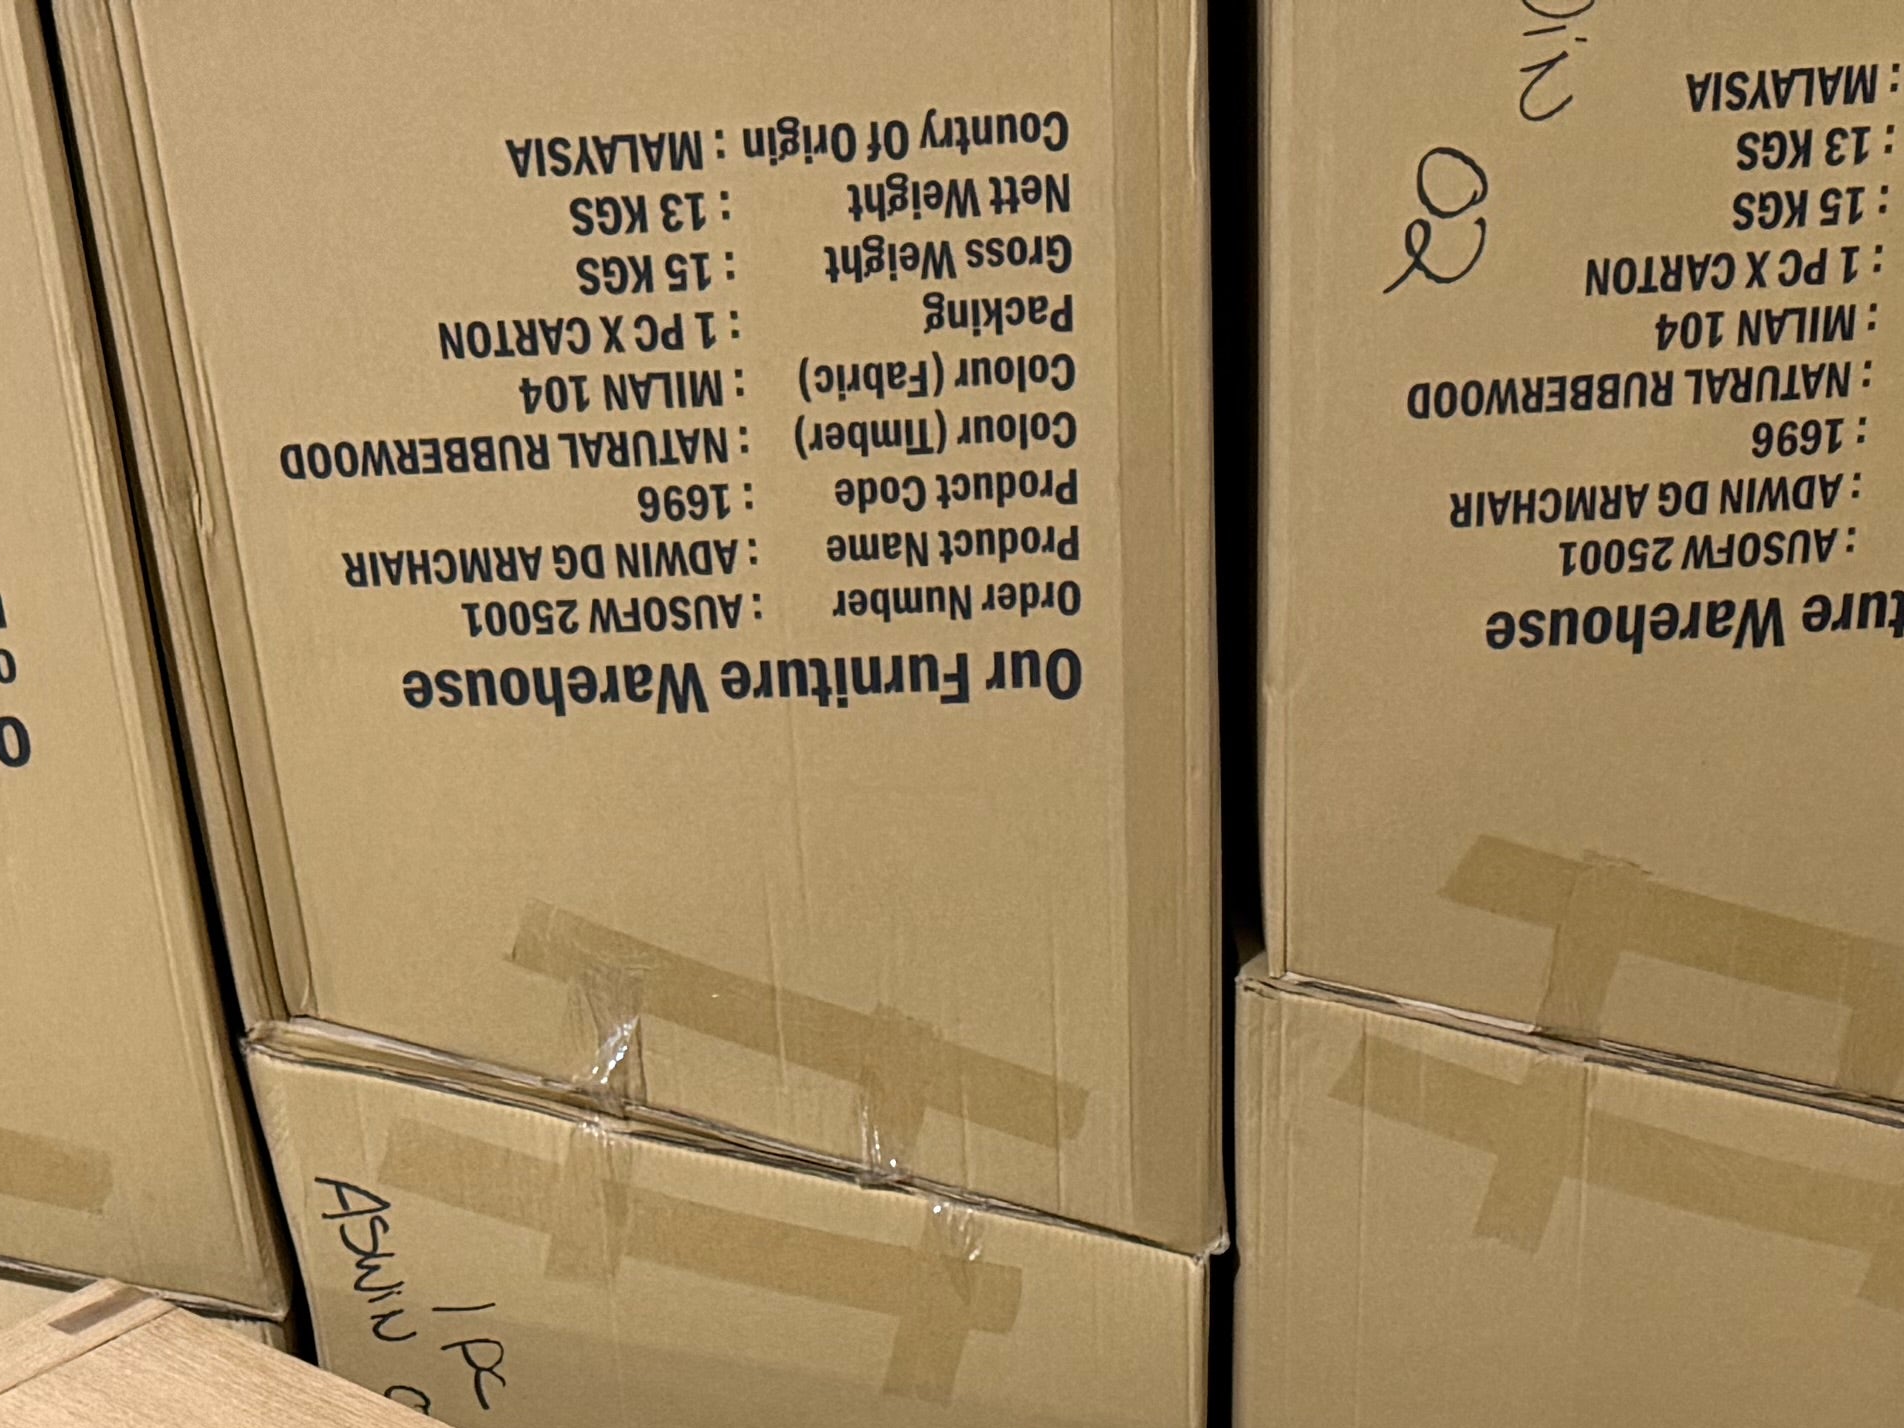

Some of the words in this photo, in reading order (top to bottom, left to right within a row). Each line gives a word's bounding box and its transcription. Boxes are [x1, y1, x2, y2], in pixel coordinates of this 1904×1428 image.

[1685, 63, 1879, 113] MALAYSIA
[1406, 369, 1674, 420] RUBBERWOOD
[1683, 360, 1852, 406] NATURAL
[557, 426, 729, 469] NATURAL
[794, 408, 947, 461] (Timber)
[956, 411, 1077, 451] Colour
[1751, 417, 1845, 459] 1696
[279, 433, 551, 480] RUBBERWOOD
[340, 545, 543, 588] ARMCHAIR
[551, 543, 606, 581] DG
[614, 538, 739, 579] ADWIN
[826, 531, 929, 568] Name
[937, 524, 1080, 566] Product
[1558, 536, 1675, 577] 25001
[1680, 527, 1839, 571] AUSOFW
[1485, 597, 1786, 655] Warehouse
[402, 662, 710, 718] Warehouse
[720, 652, 970, 709] Furniture
[985, 647, 1082, 701] Our
